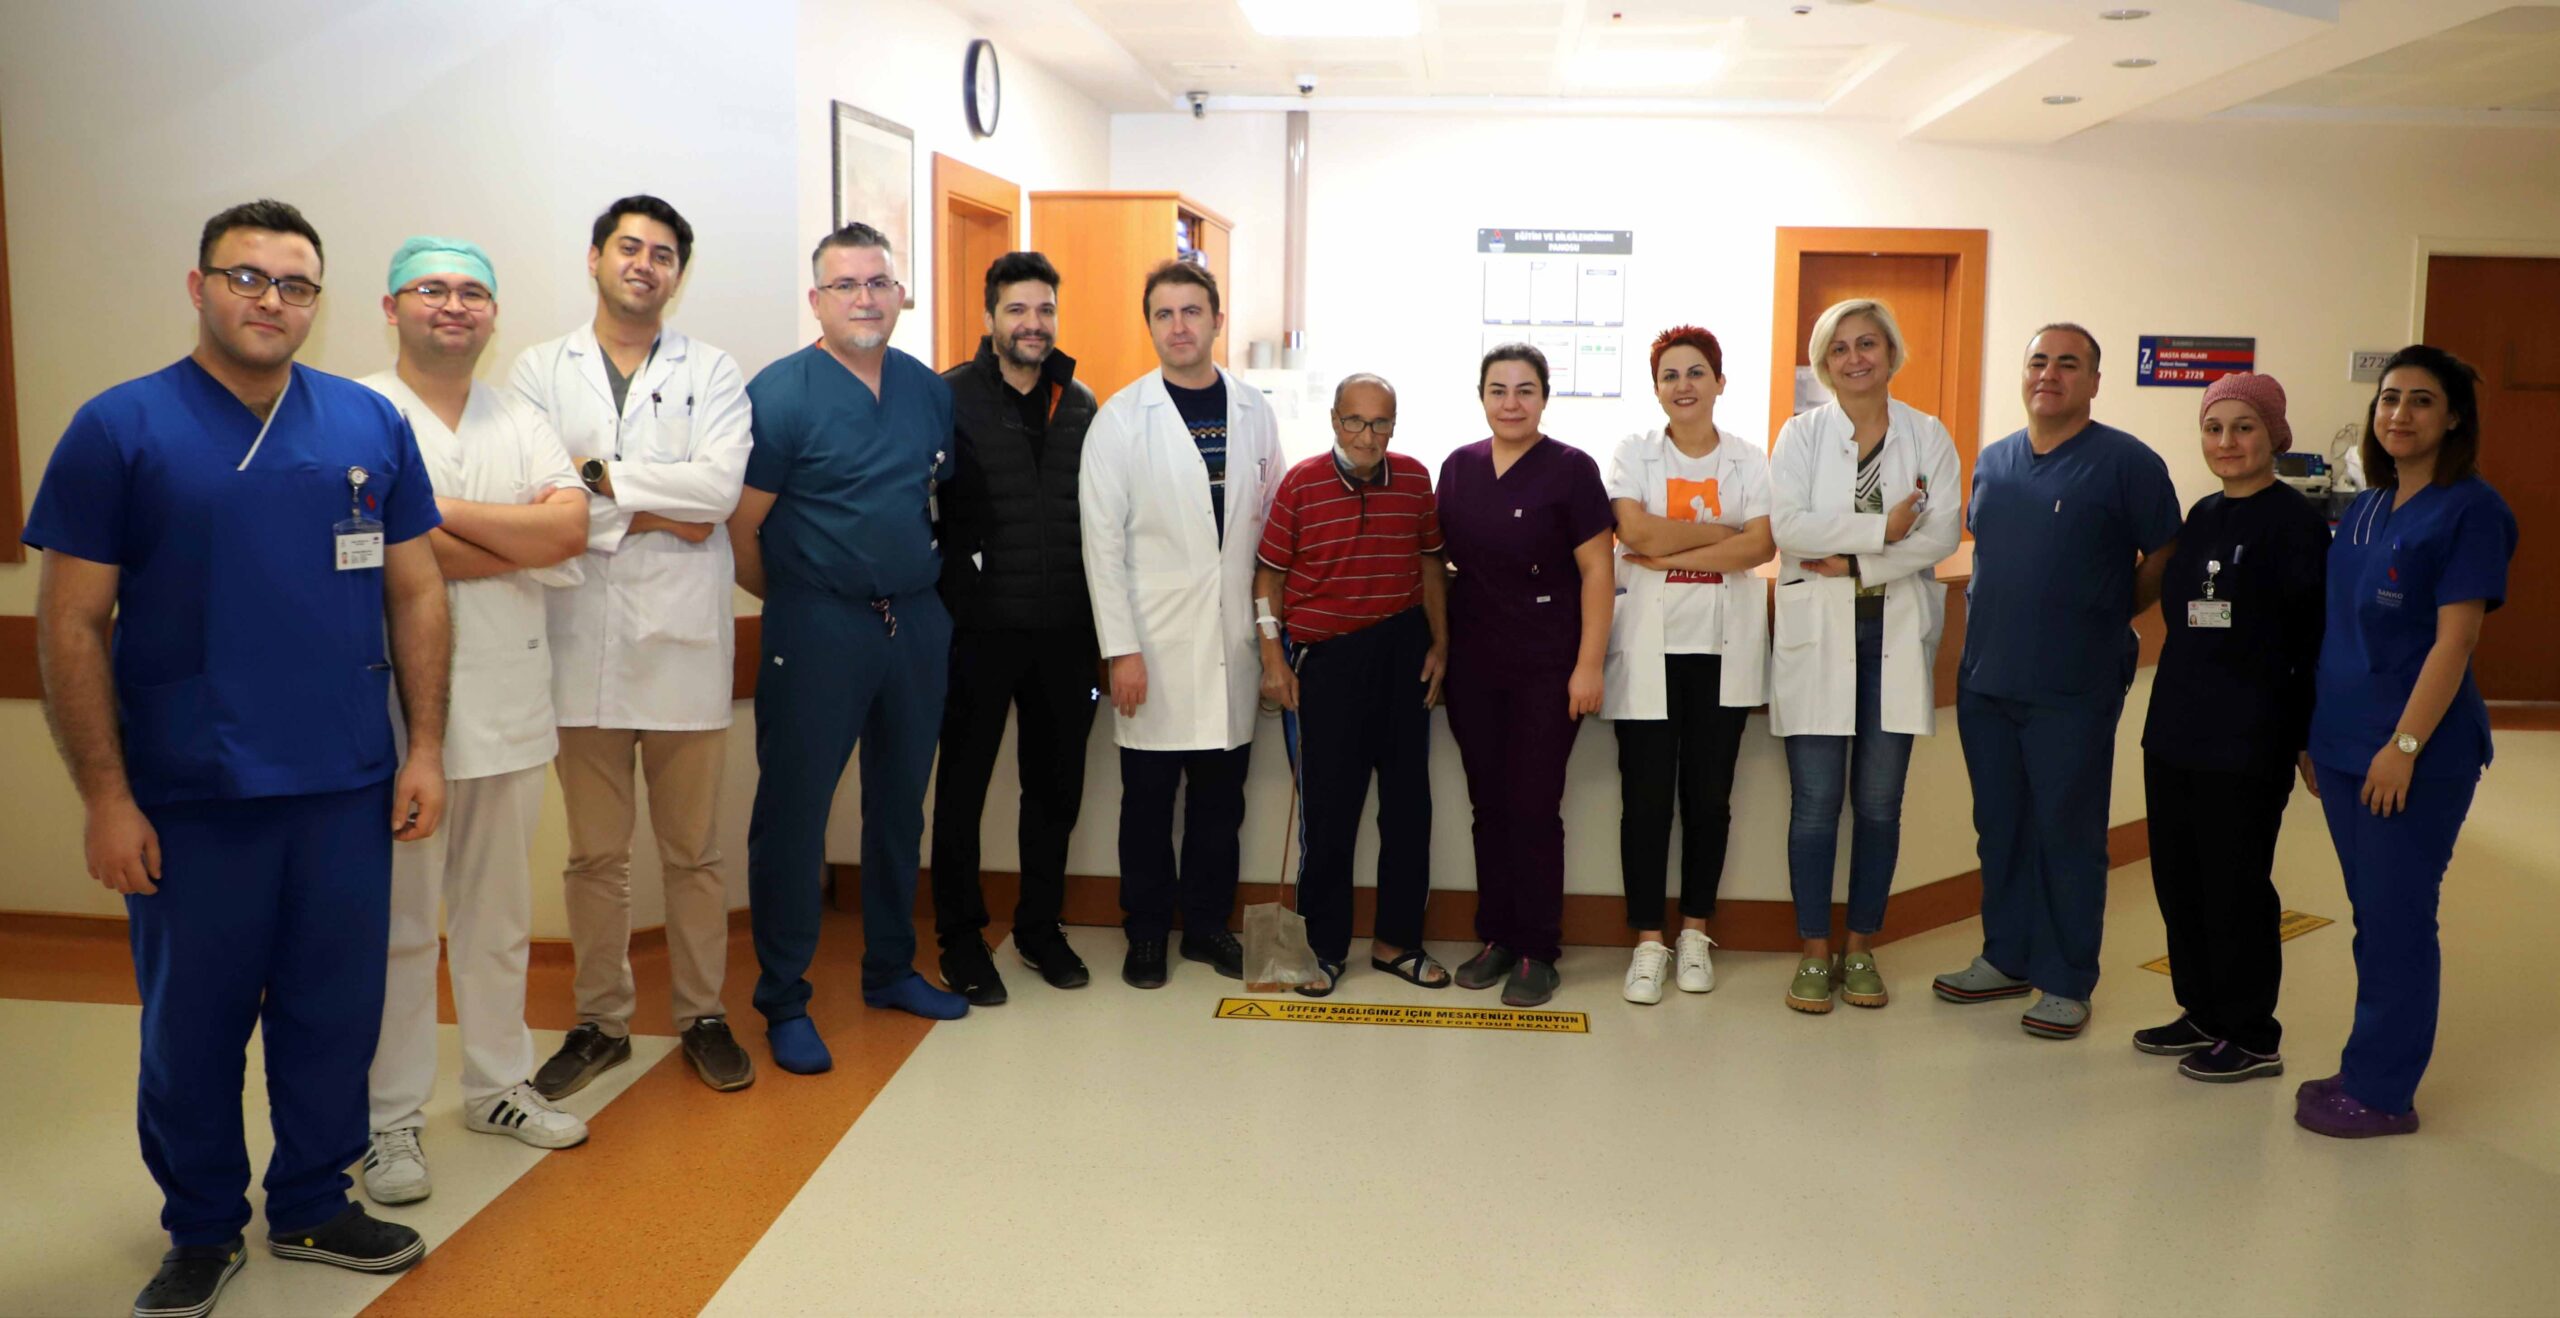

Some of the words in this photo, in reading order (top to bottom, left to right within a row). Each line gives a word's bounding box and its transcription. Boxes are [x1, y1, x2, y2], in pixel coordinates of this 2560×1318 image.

[2158, 370, 2177, 379] 2719
[2185, 371, 2204, 379] 2729
[2378, 588, 2404, 600] SANKO
[1280, 1004, 1326, 1014] LÜTFEN
[1405, 1009, 1432, 1019] İÇİN
[1436, 1011, 1514, 1020] MESAFENİZİ
[1518, 1014, 1579, 1023] KORUYUN
